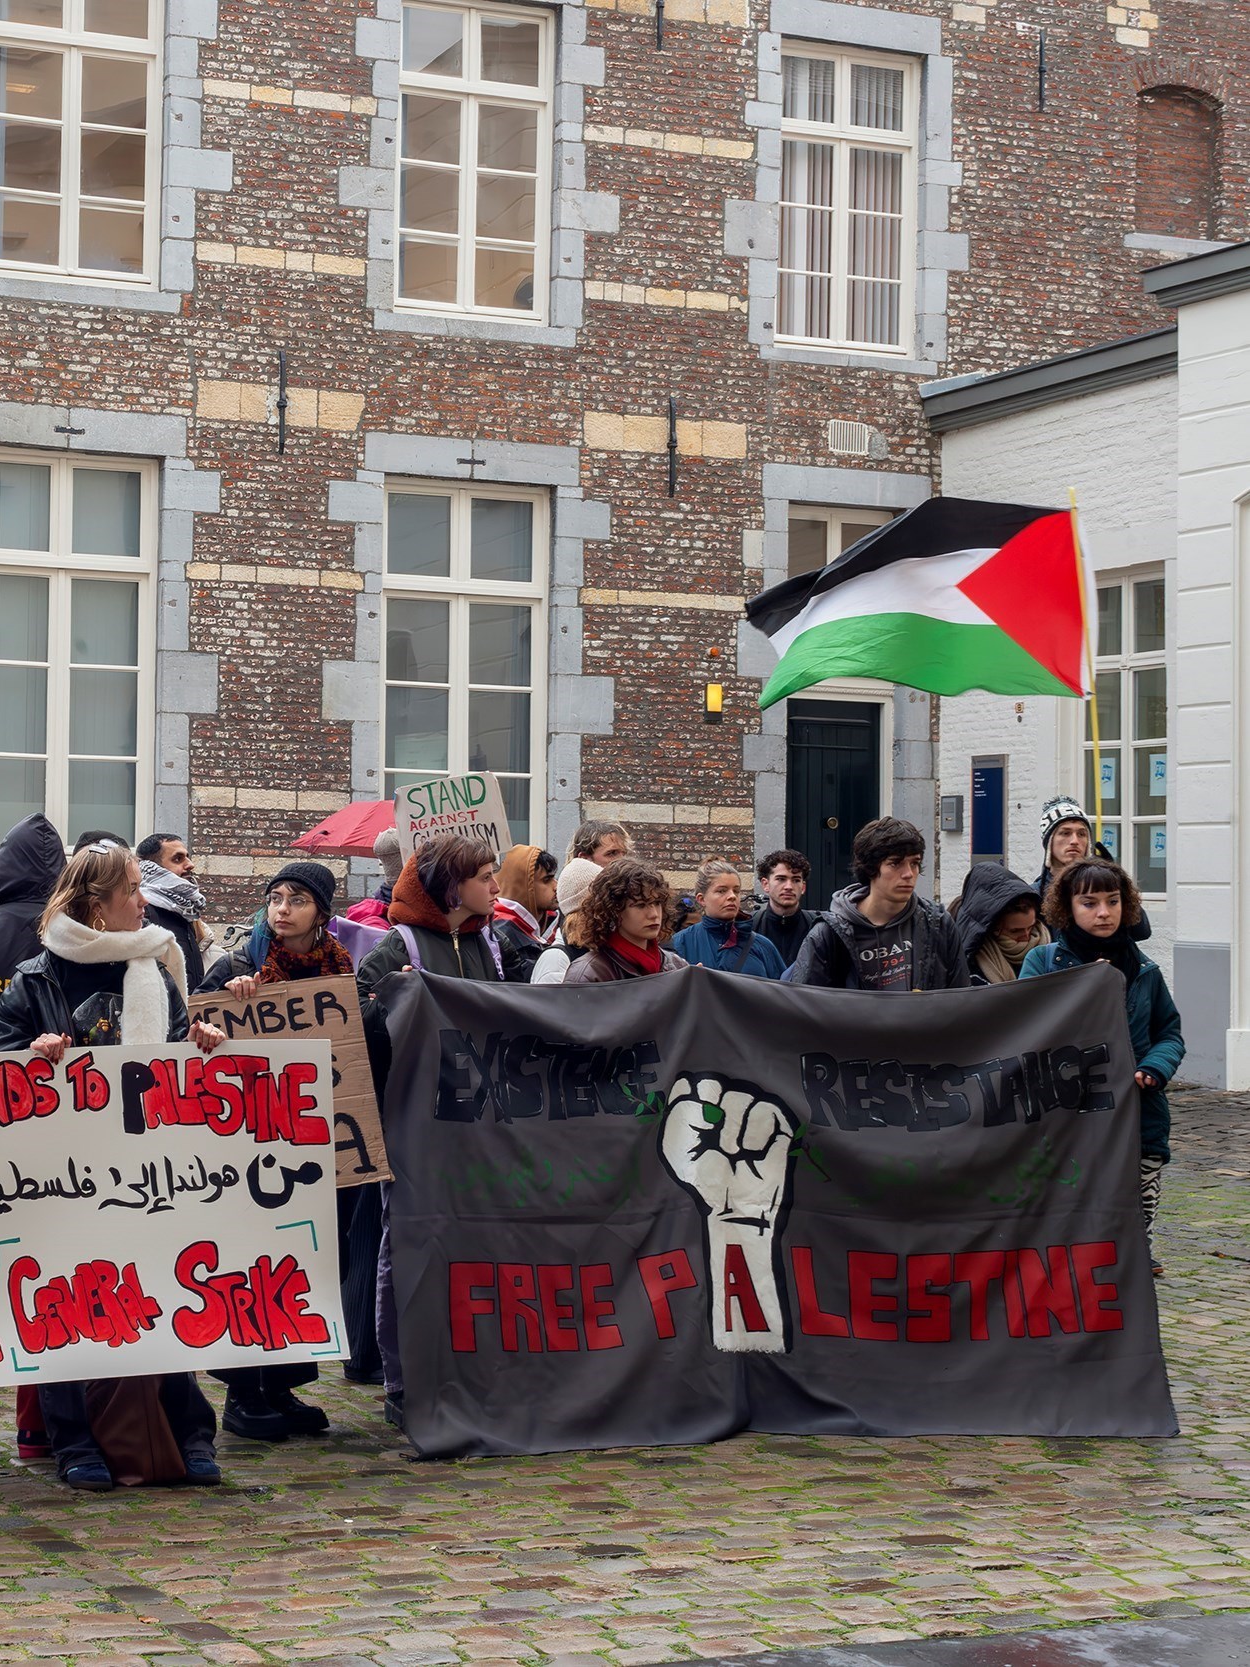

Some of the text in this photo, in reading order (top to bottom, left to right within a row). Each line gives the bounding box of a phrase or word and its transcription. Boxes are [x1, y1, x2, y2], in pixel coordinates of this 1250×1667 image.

[407, 775, 486, 819] STAND
[410, 810, 478, 831] AGAINST
[66, 1051, 110, 1112] TO
[121, 1055, 331, 1145] PALESTINE
[434, 1029, 1114, 1132] EXISTENCE RESISTANCE
[164, 1154, 240, 1203] هولندا
[246, 1153, 323, 1209] من
[7, 1255, 163, 1354] GENERAL
[172, 1240, 332, 1350] STRIKE
[450, 1261, 625, 1353] FREE
